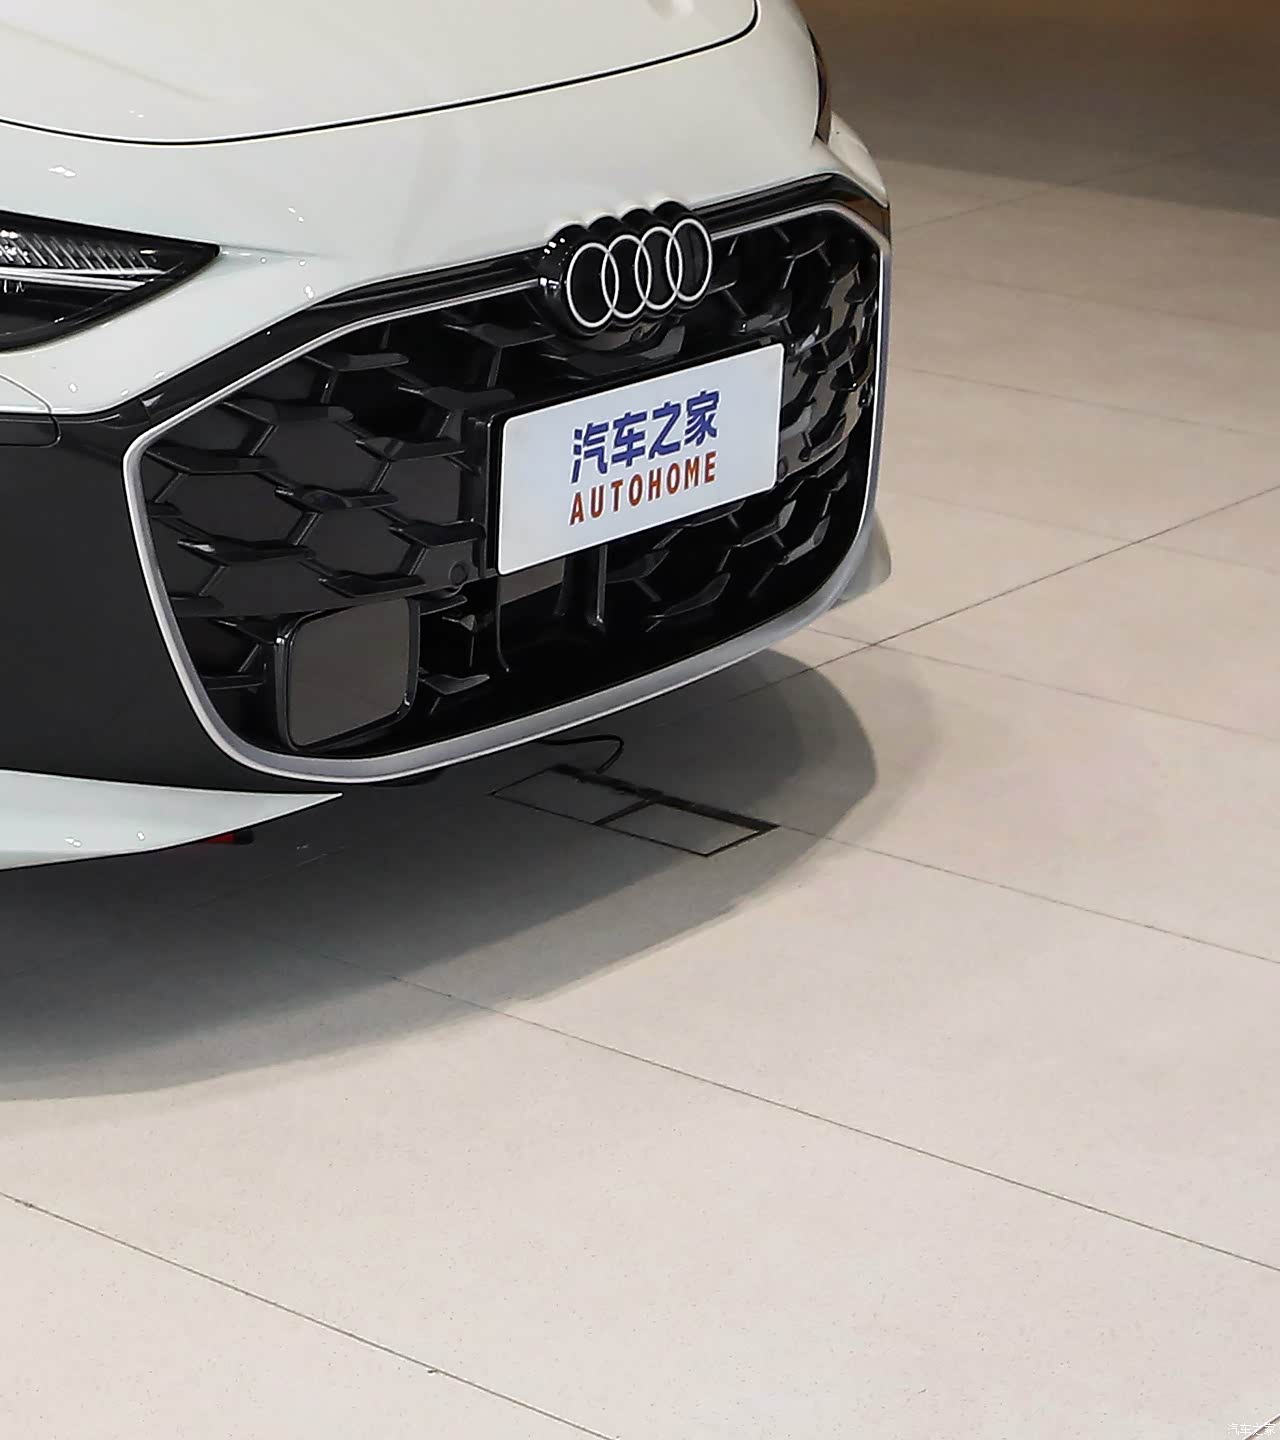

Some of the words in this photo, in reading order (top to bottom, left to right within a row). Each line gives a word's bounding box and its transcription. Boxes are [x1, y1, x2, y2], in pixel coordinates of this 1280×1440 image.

[571, 391, 720, 484] 汽车之家
[570, 451, 716, 525] AUTOHOME
